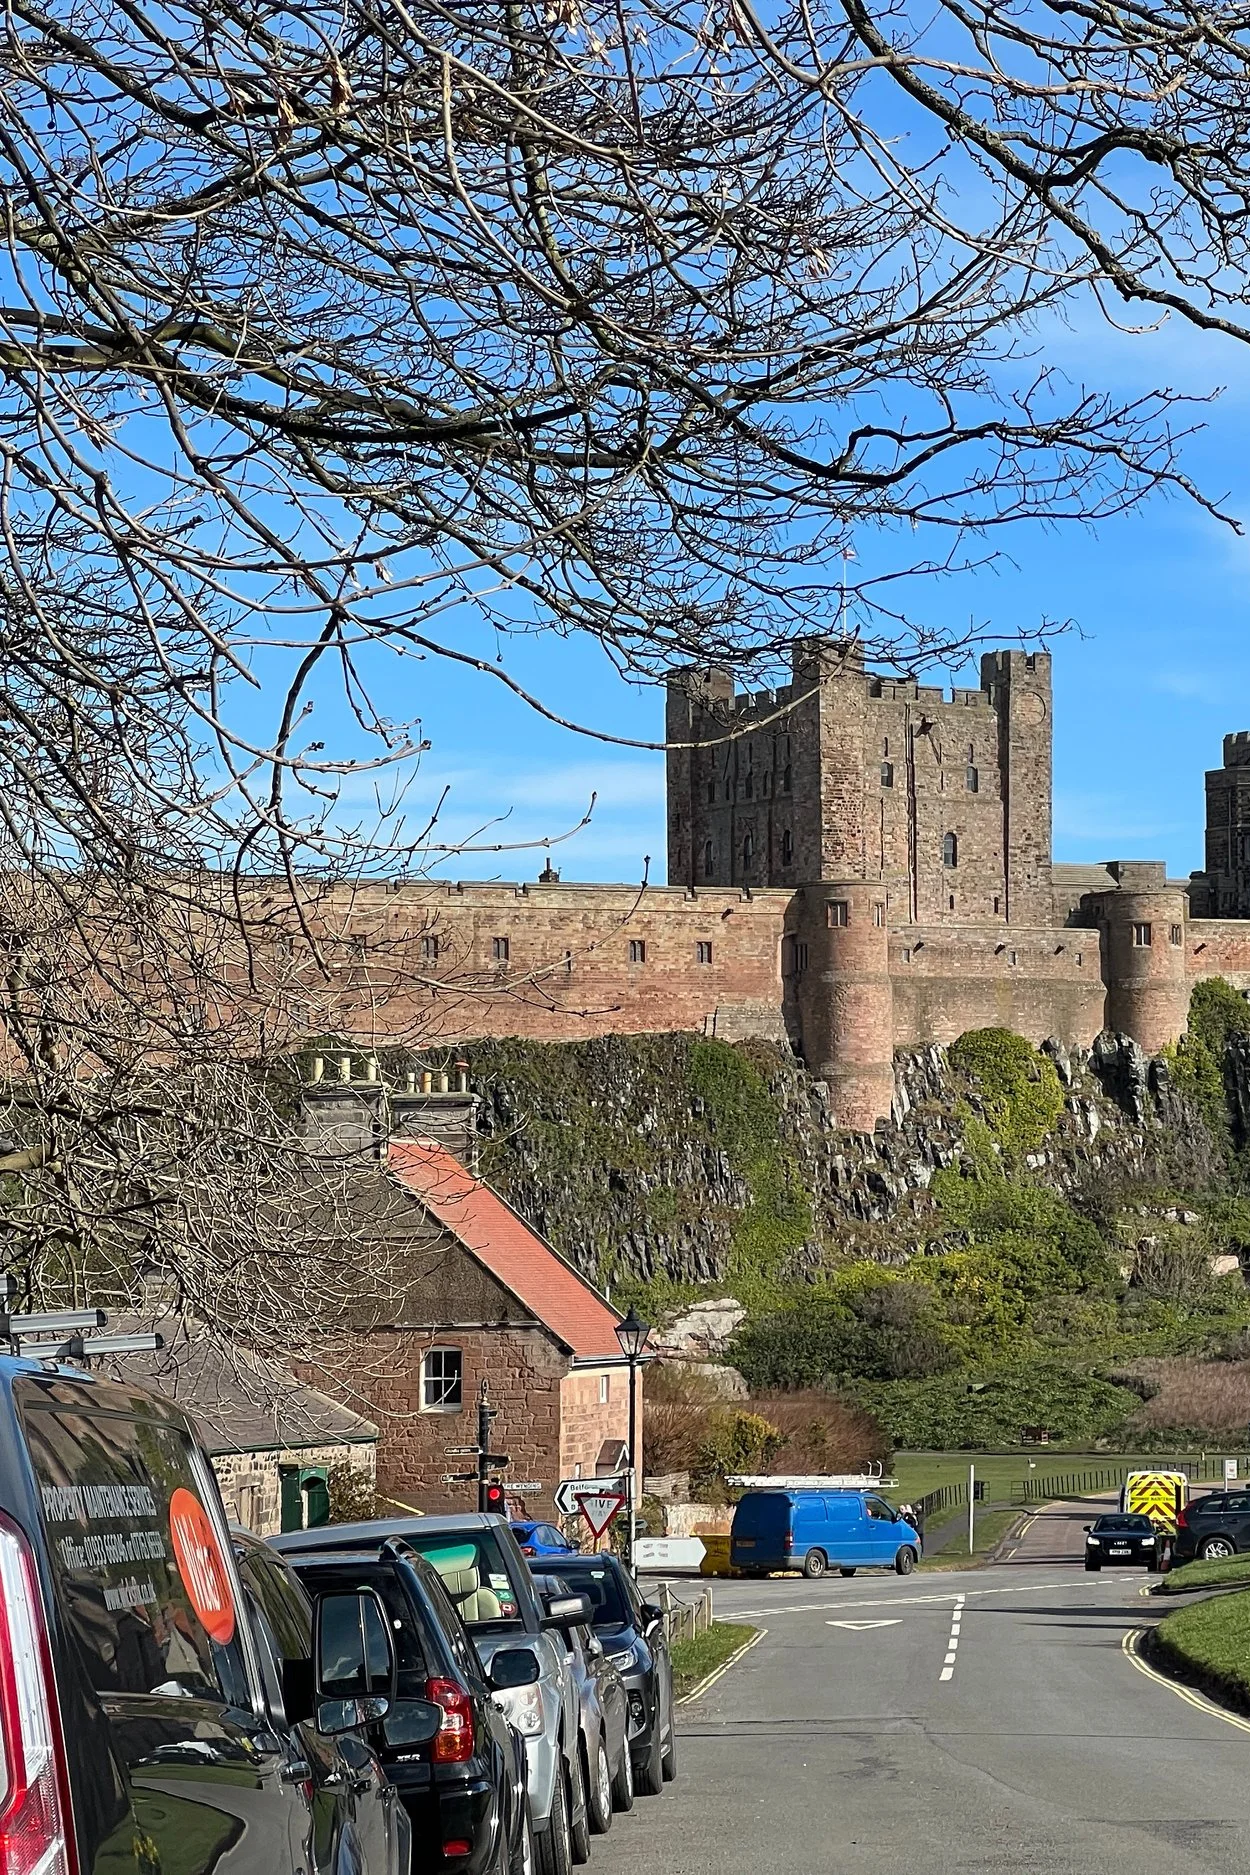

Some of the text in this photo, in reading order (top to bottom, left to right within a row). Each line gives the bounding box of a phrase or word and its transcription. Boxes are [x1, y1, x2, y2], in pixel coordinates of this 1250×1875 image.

[41, 1485, 157, 1522] PROPERTY MAINTENANCE SERVICES
[60, 1536, 88, 1569] Office:
